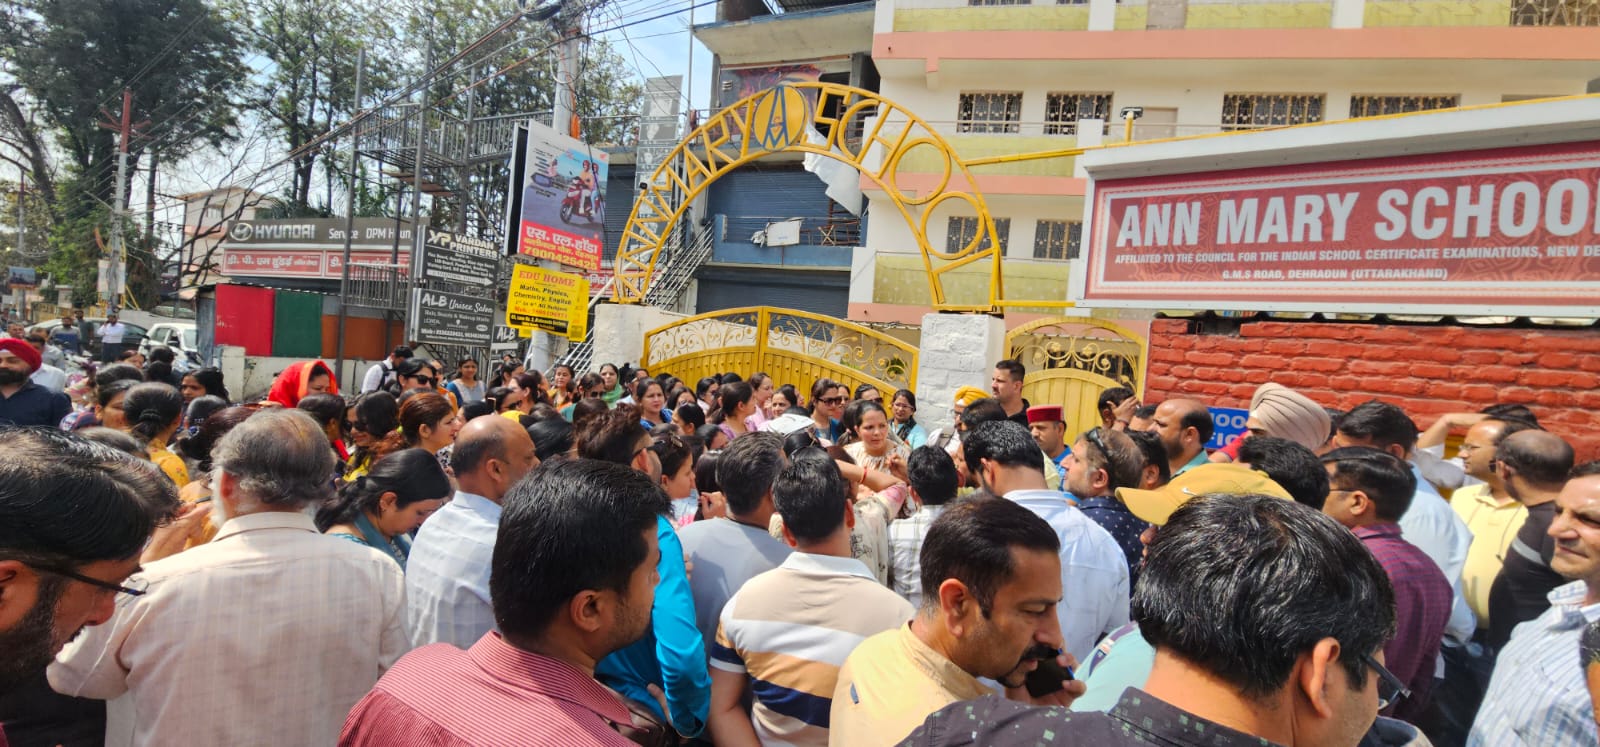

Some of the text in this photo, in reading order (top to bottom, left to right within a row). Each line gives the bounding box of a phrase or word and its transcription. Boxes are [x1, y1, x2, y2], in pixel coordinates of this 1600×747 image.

[652, 98, 755, 219] MARY
[801, 86, 996, 304] SCHOOL
[1116, 178, 1600, 247] ANN MARY SCHOO
[255, 224, 315, 239] HYUNDAI
[366, 228, 386, 238] DPM
[455, 233, 494, 250] VARDAN
[450, 242, 497, 258] PRINTERS
[1115, 254, 1160, 264] AFFILIATED
[1163, 253, 1173, 263] TO
[1176, 253, 1193, 263] THE
[1195, 252, 1235, 263] COUNCIL
[1238, 252, 1257, 262] FOR
[1260, 251, 1278, 261] THE
[1281, 251, 1316, 261] INDIAN
[1319, 250, 1362, 260] SCHOOL
[1365, 248, 1440, 260] CERTIFICATE
[1443, 246, 1543, 259] EXAMINATIONS,
[1547, 246, 1578, 256] NEW
[519, 271, 540, 281] EDU
[544, 273, 575, 287] HOME
[1223, 268, 1448, 281] G.M.S ROAD, DEHRADUN (UTTARAKHAND)
[543, 287, 569, 297] Physics,
[422, 293, 447, 307] ALB
[449, 299, 473, 310] Unisex
[549, 296, 572, 306] English
